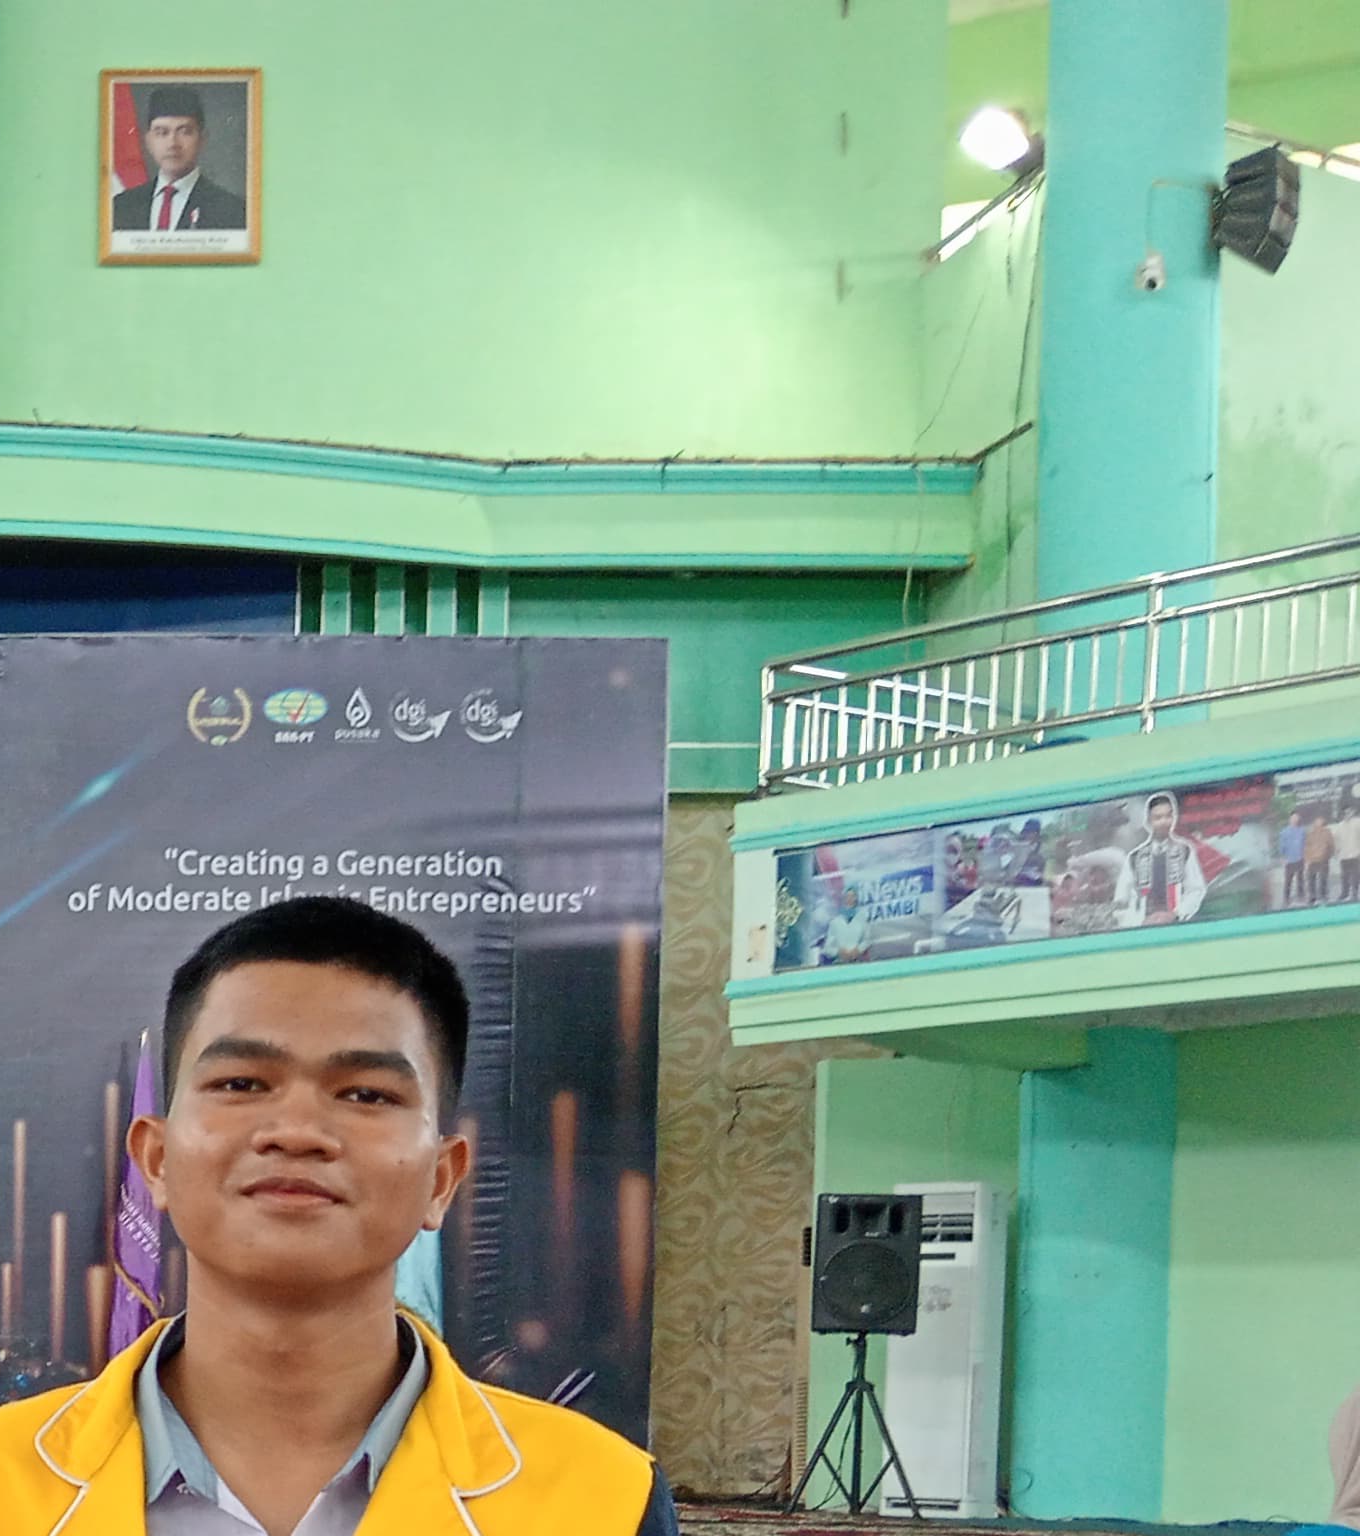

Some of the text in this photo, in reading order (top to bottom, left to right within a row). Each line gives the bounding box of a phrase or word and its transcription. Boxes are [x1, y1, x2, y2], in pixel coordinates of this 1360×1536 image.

[312, 855, 329, 875] a
[337, 850, 502, 877] Generation
[68, 884, 102, 912] of
[107, 884, 252, 912] Moderate
